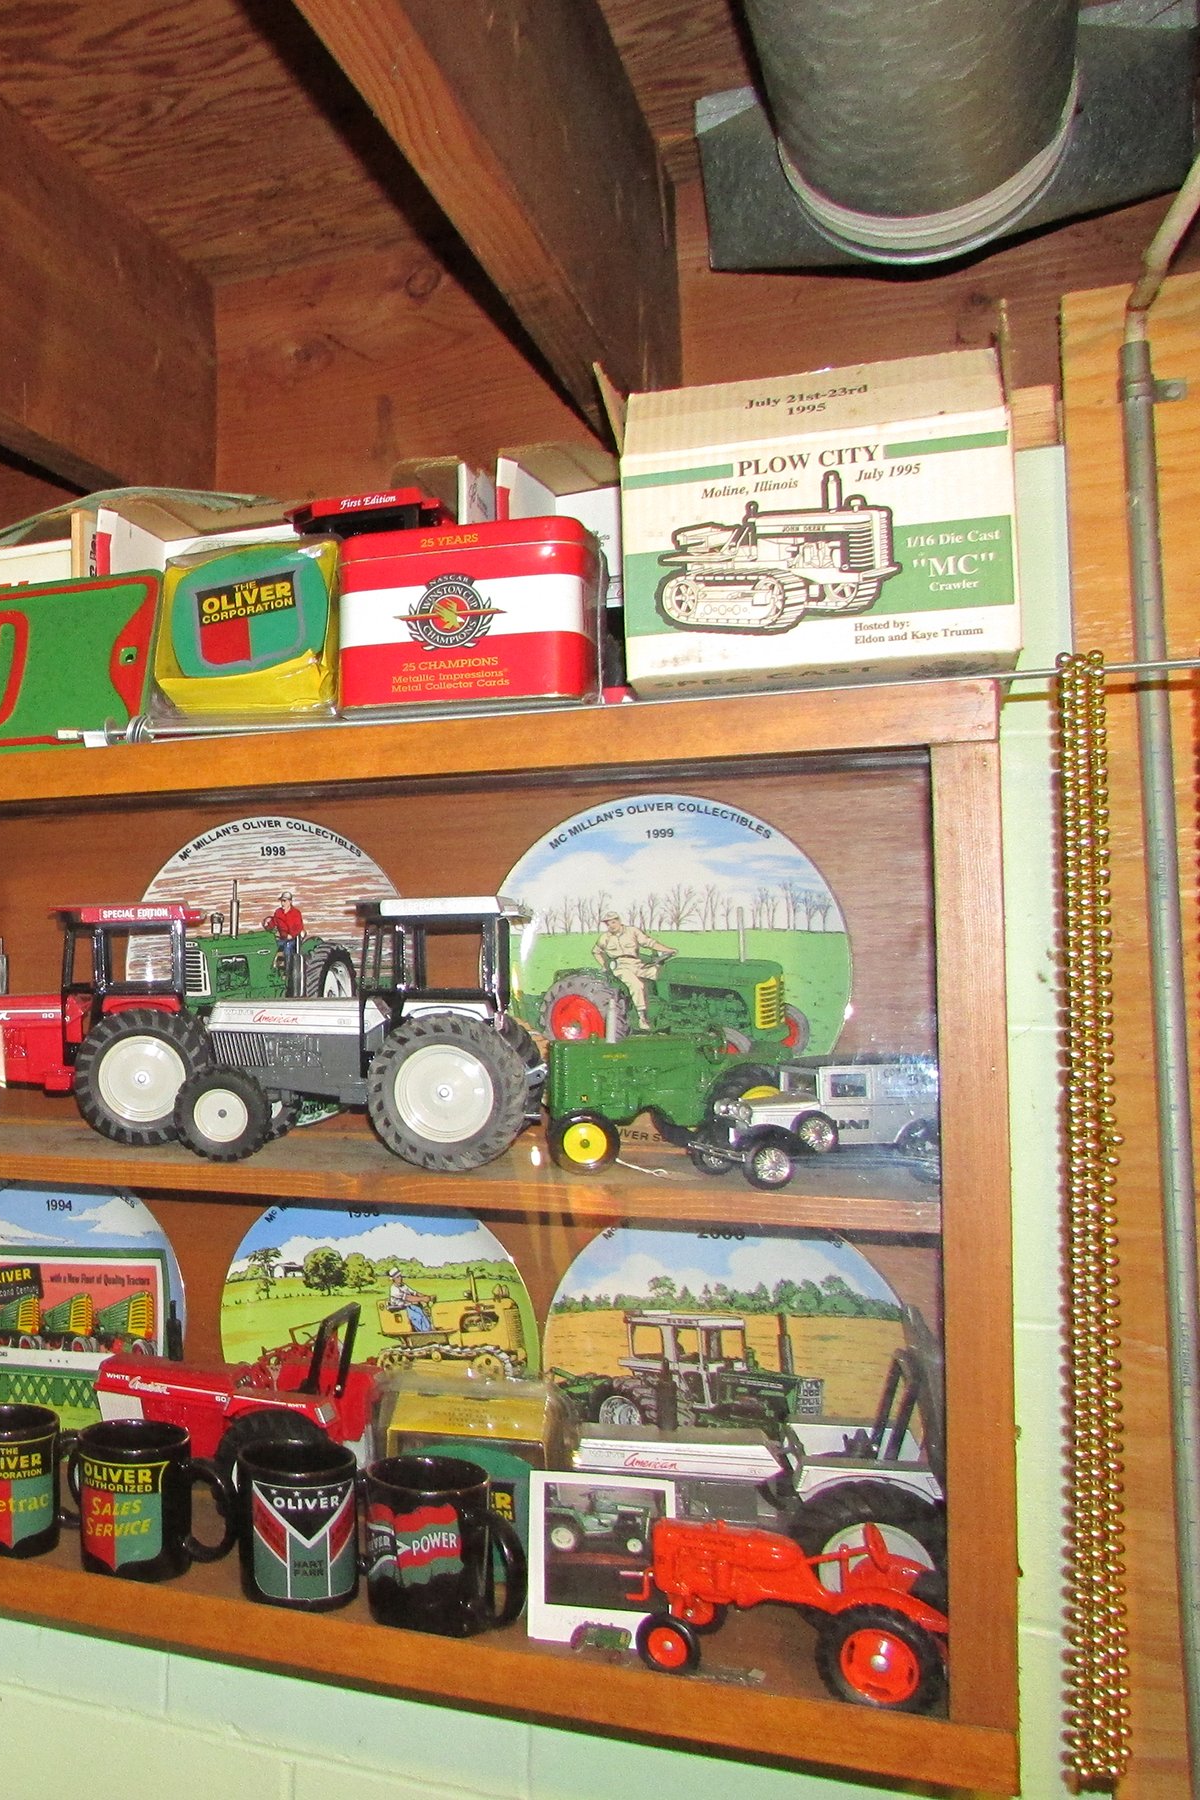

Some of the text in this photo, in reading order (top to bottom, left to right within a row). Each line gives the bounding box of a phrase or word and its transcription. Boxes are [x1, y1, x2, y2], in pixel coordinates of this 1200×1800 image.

[745, 384, 869, 411] July 21st-23rd
[787, 402, 827, 416] 1995
[738, 444, 881, 477] PLOW CITY
[855, 462, 921, 483] July 1995
[701, 477, 799, 500] Moline, Illinois
[340, 492, 397, 510] First Edition
[420, 533, 479, 548] 25 YEARS
[905, 528, 1001, 549] 1/16 Die Cast
[233, 580, 257, 591] THE
[428, 574, 469, 587] NASCAR
[929, 578, 979, 591] Crawler
[202, 581, 291, 614] OLIVER
[421, 586, 478, 610] WINSTON CUP
[202, 597, 293, 624] CORPORATION
[422, 620, 477, 645] CHAMPIONS
[854, 619, 910, 632] Hosted by:
[854, 626, 984, 645] Eldon and Kaye Trumm
[402, 657, 499, 672] 25 CHAMPIONS
[391, 677, 510, 693] Metal Collector Cards
[392, 672, 436, 684] Metallic
[548, 802, 773, 850] MC MILLAN'S OLIVER COLLECTIBLES
[645, 828, 675, 839] 1999
[191, 824, 240, 851] MILLAN'S
[242, 819, 282, 831] OLIVER
[286, 821, 362, 858] COLLECTIBLES
[260, 846, 287, 857] 1998
[102, 908, 169, 919] SPECIAL EDITION
[252, 1009, 301, 1025] American
[46, 1199, 73, 1212] 1994
[106, 1372, 130, 1381] WHITE
[0, 1447, 19, 1456] THE
[624, 1452, 679, 1470] American
[84, 1464, 153, 1484] OLIVER
[84, 1479, 154, 1494] AUTHORIZED
[92, 1497, 143, 1516] SALES
[273, 1495, 341, 1510] OLIVER
[86, 1517, 152, 1537] SERVICE
[412, 1531, 458, 1556] POWER
[293, 1559, 325, 1569] HART
